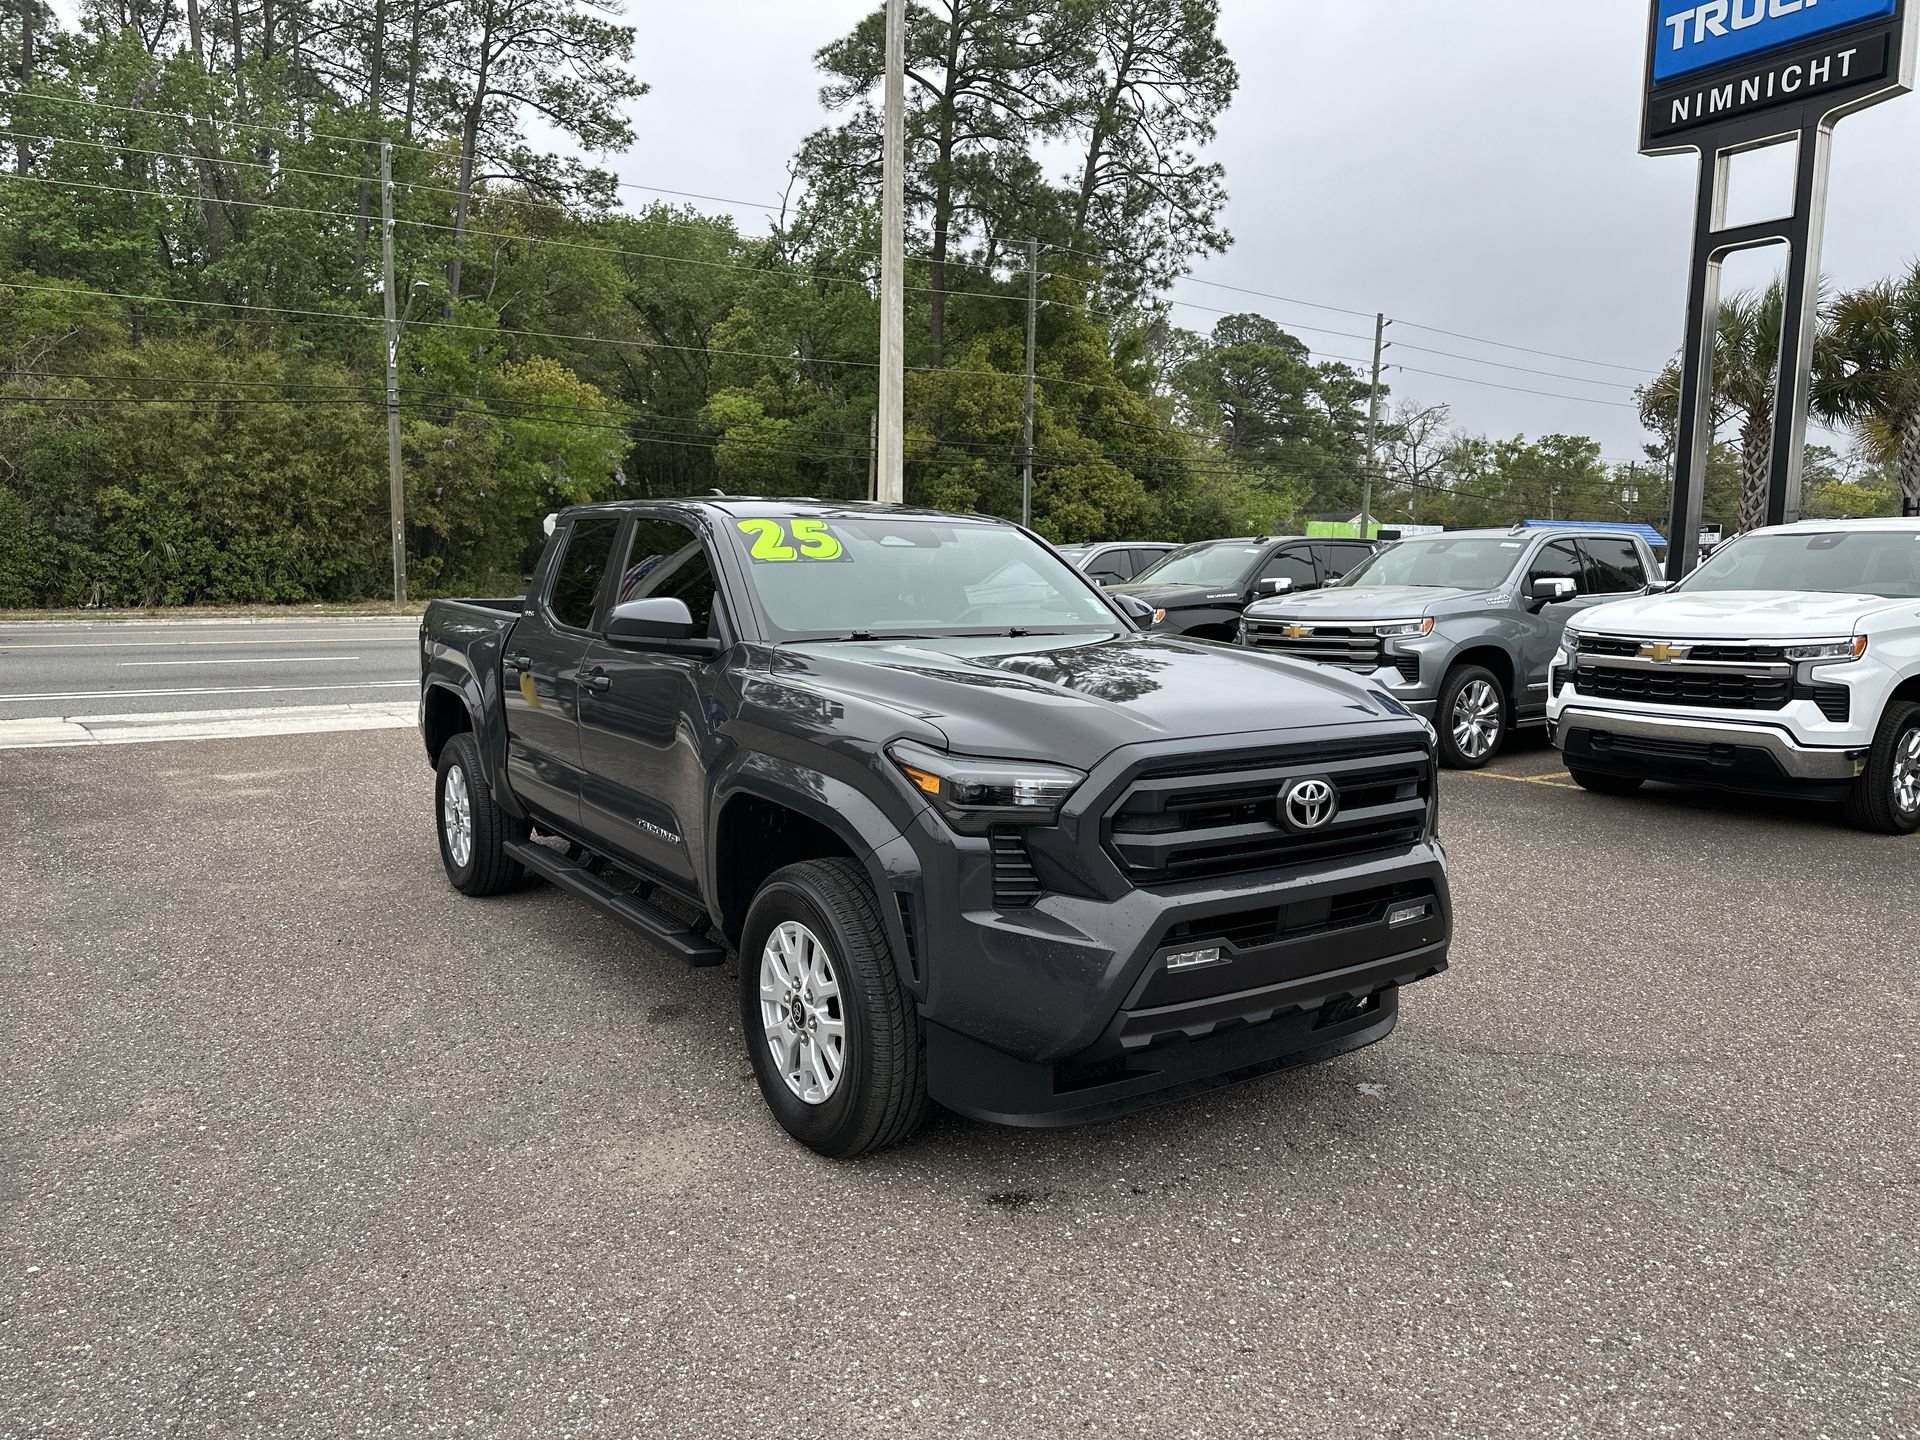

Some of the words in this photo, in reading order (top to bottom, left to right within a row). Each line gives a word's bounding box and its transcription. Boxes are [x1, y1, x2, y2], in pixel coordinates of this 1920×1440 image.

[1665, 0, 1817, 51] TRU
[1671, 48, 1857, 124] NIMNICHT
[737, 518, 843, 562] 25
